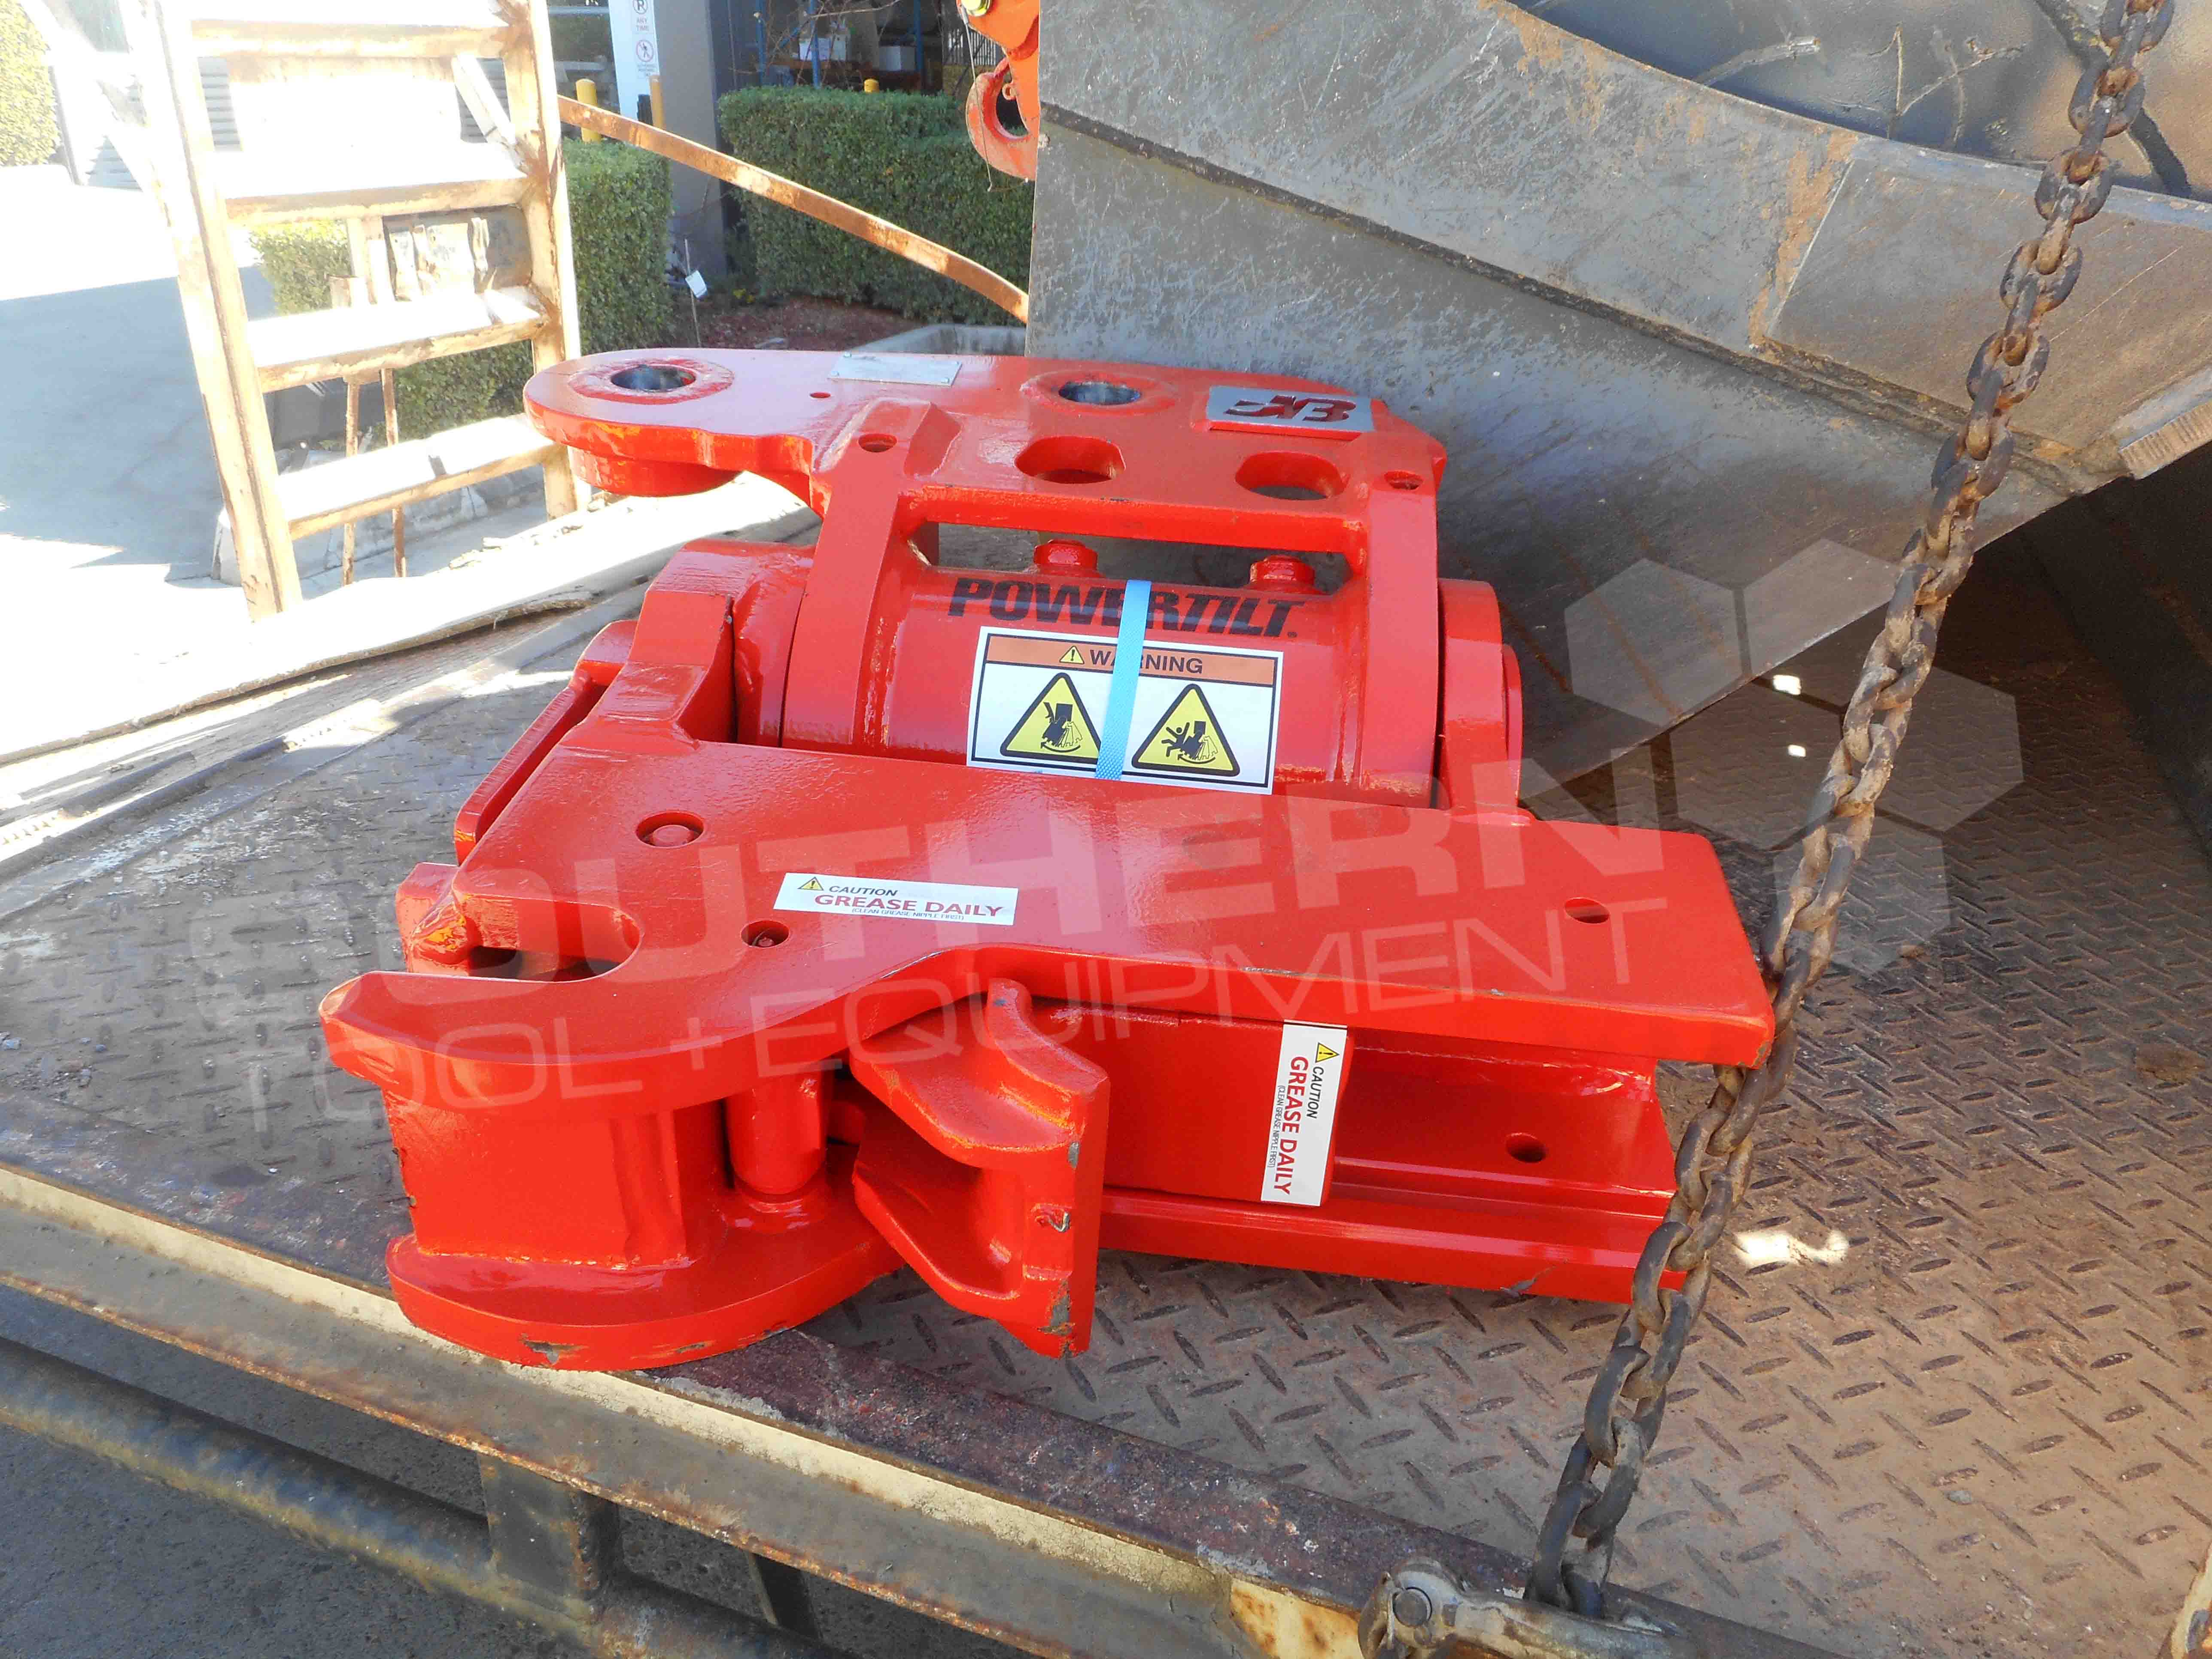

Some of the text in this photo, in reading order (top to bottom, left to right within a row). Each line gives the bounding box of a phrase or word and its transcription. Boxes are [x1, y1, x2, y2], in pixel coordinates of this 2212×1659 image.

[1089, 649, 1203, 675] WNING
[829, 885, 898, 897] CAUTION
[814, 894, 1003, 917] GREASE DAILY
[1306, 1066, 1324, 1119] CAUTION
[1274, 1056, 1309, 1195] GREASE DAILY
